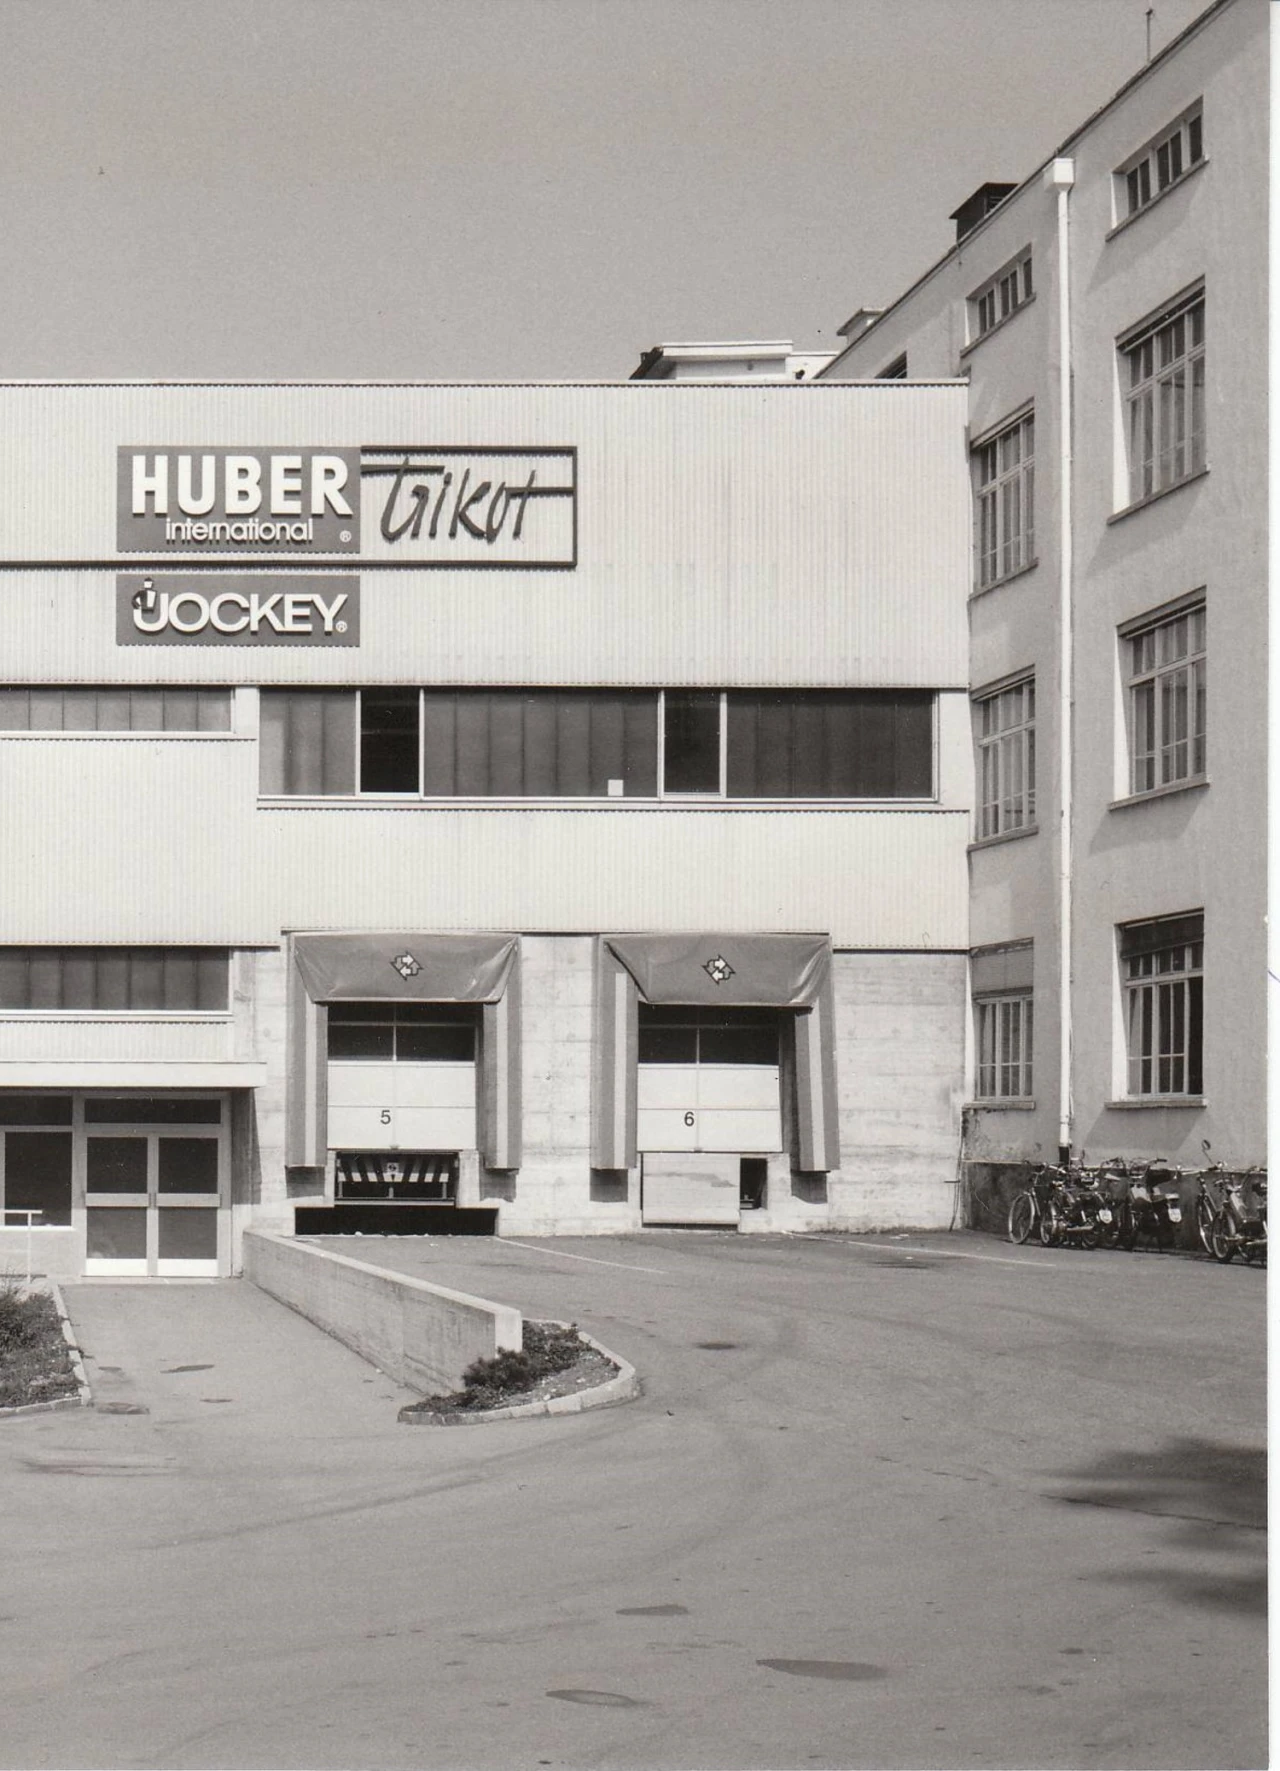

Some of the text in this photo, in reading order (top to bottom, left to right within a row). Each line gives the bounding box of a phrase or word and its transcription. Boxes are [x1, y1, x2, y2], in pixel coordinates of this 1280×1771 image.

[131, 455, 354, 516] HUBER
[166, 518, 314, 542] international
[133, 592, 349, 632] JOCKEY
[380, 1109, 392, 1125] 5
[683, 1111, 695, 1127] 6
